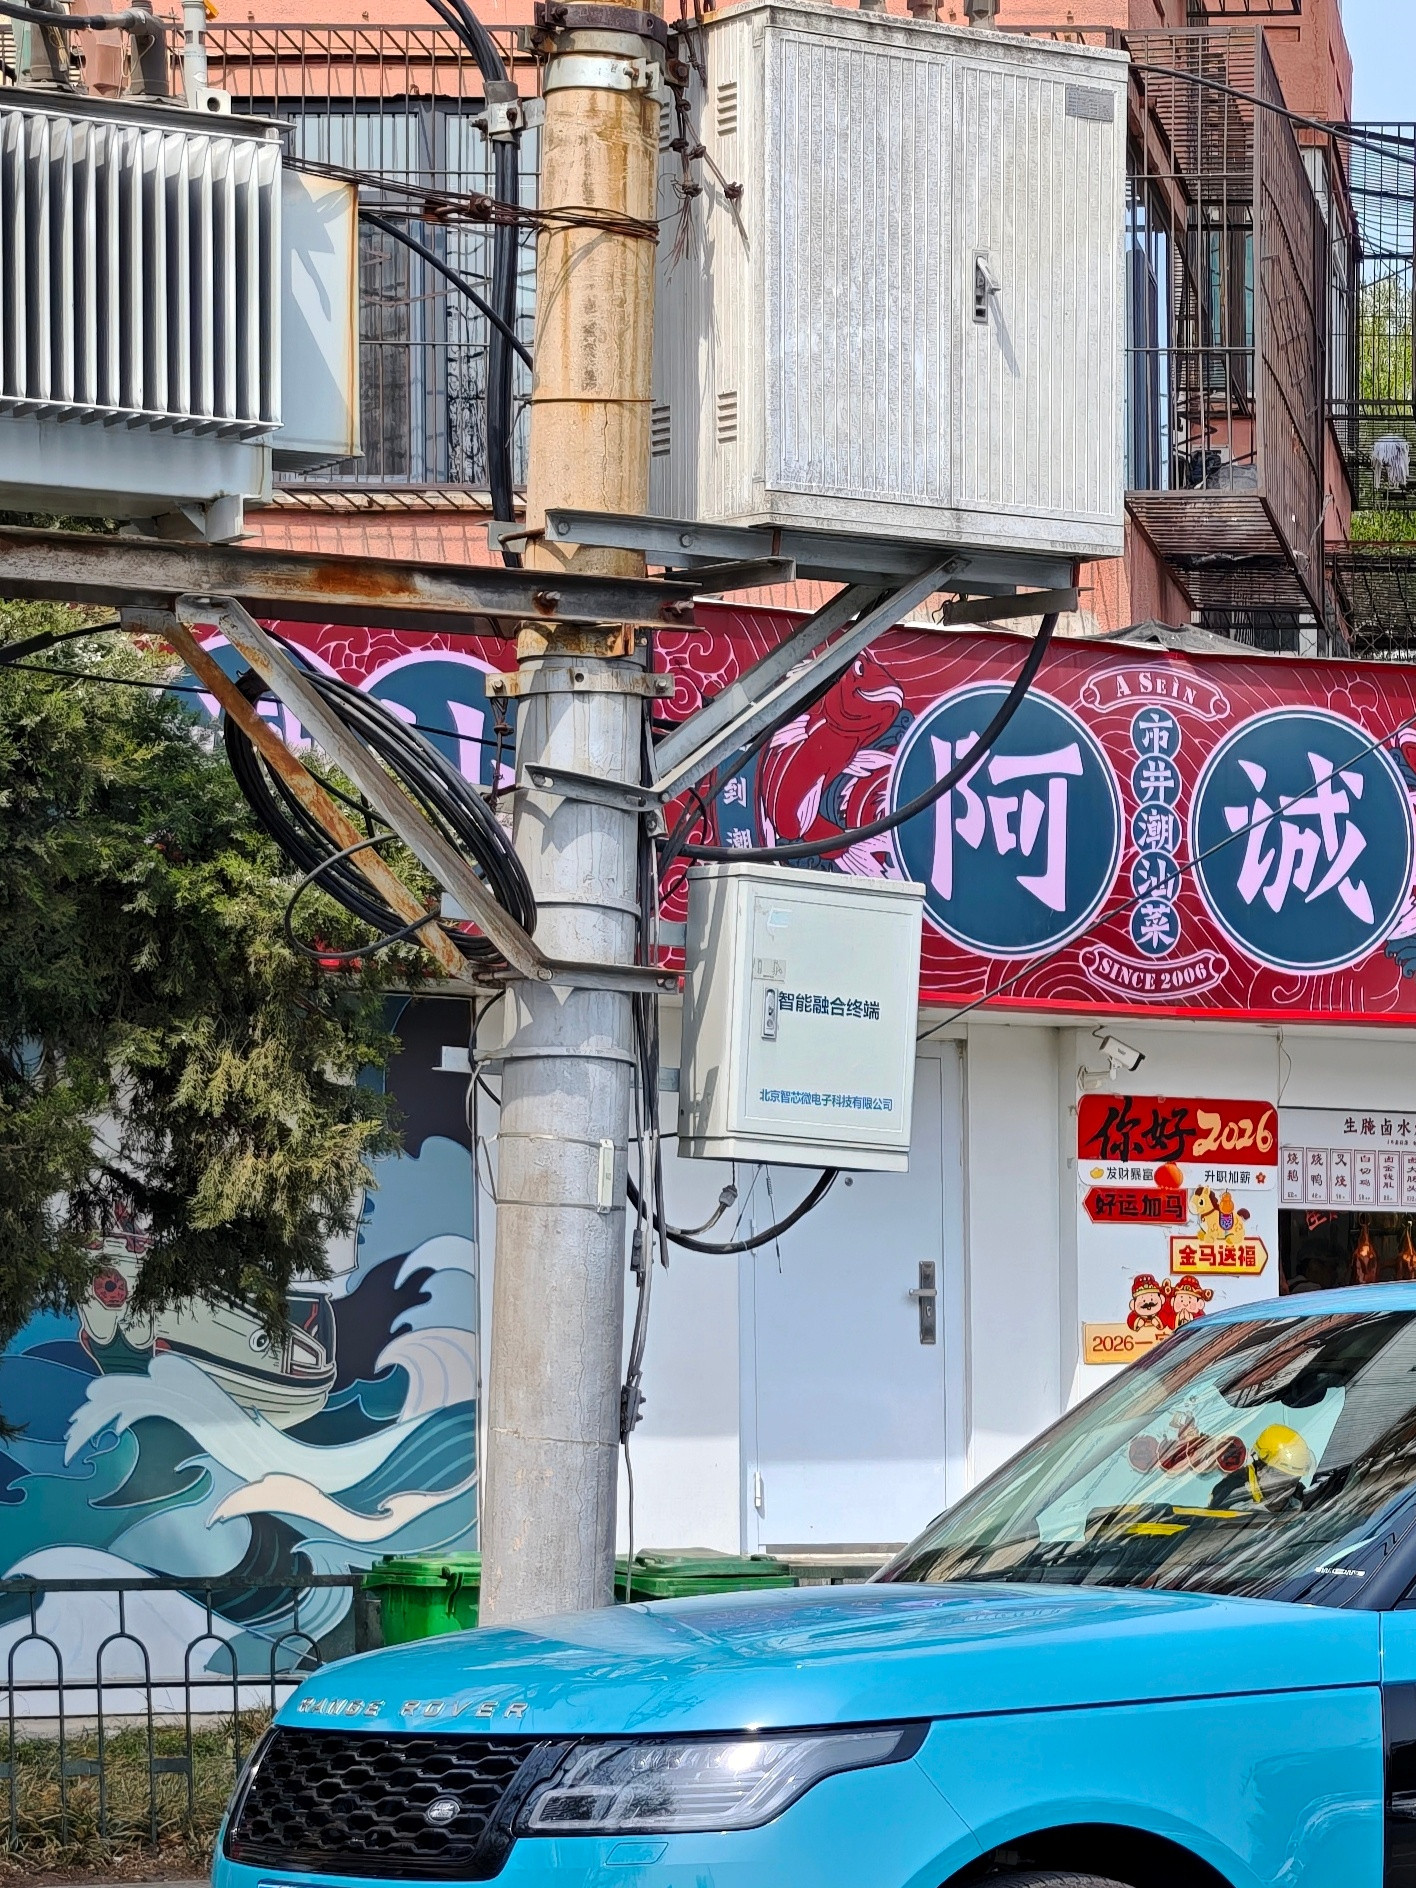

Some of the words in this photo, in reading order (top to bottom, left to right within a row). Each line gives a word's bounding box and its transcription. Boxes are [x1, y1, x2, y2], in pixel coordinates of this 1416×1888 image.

[1116, 674, 1132, 697] A
[930, 730, 1083, 911] 阿
[1224, 752, 1375, 925] 诚
[1137, 712, 1175, 950] 市井潮汕菜
[1098, 956, 1156, 990] SINCE
[1160, 962, 1208, 991] 2006
[778, 990, 881, 1021] 智能融合终端
[759, 1088, 893, 1112] 北京智芯微电子科技有限公司
[1085, 1095, 1197, 1162] 你好
[1192, 1109, 1274, 1157] 2026
[1106, 1166, 1154, 1182] 发财暴富
[1204, 1169, 1251, 1185] 升职加薪
[1310, 1153, 1324, 1187] 烧鸭
[1334, 1154, 1348, 1188] 叉烧
[1359, 1155, 1372, 1187] 白切鸡
[1095, 1194, 1184, 1218] 好运加马
[1178, 1244, 1257, 1268] 金马送福
[297, 1696, 385, 1717] RANGE
[400, 1700, 530, 1719] ROVER
